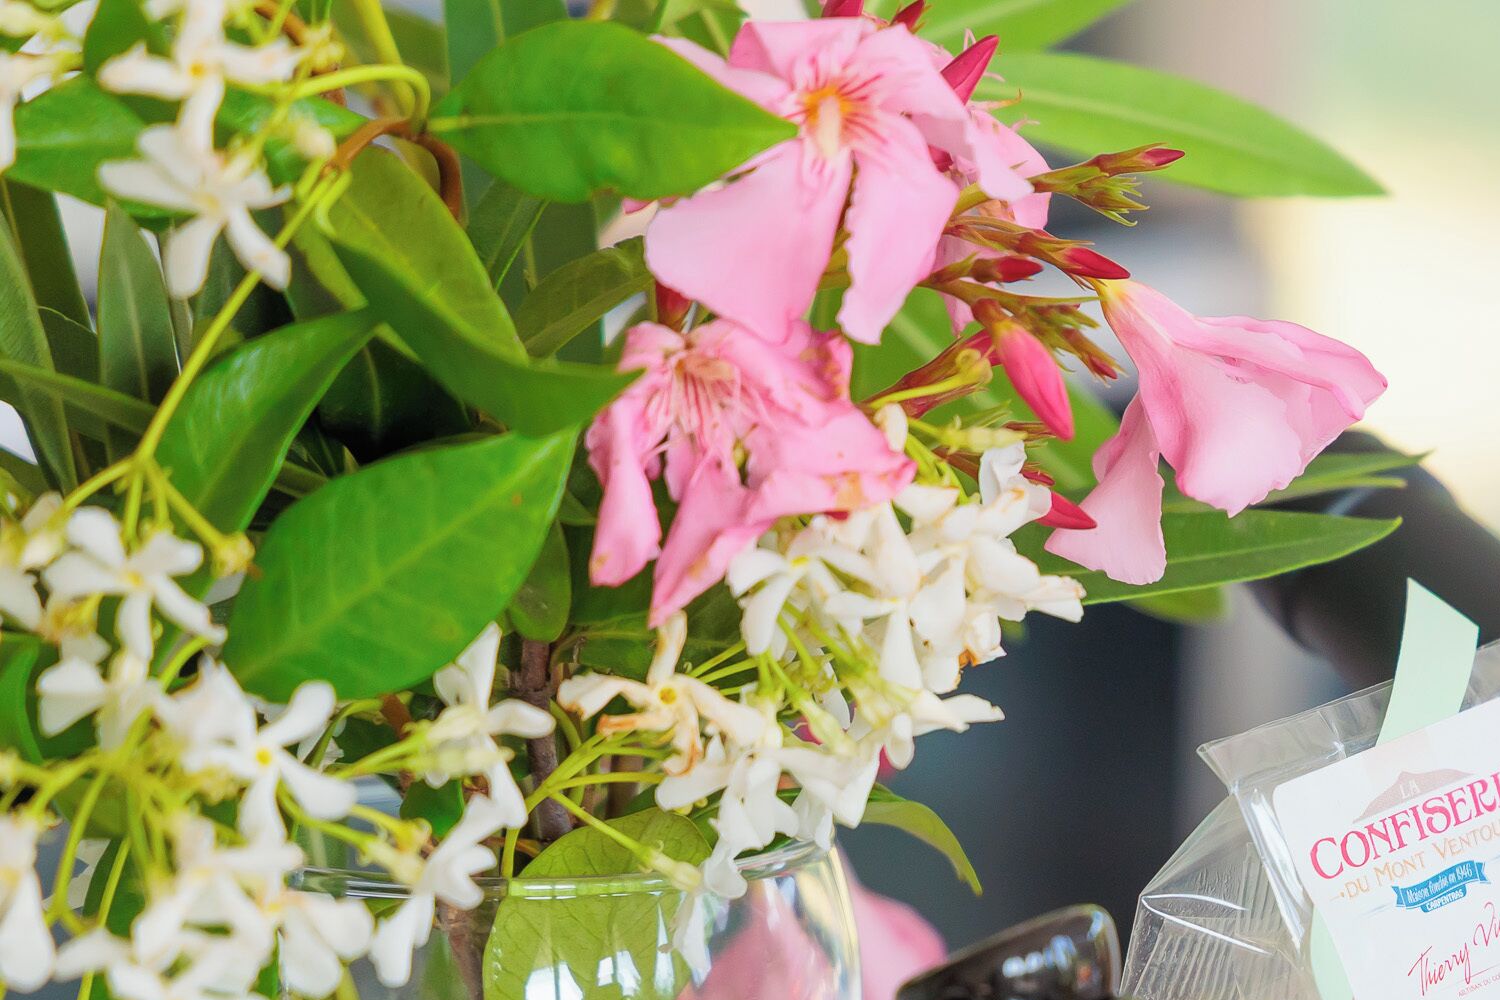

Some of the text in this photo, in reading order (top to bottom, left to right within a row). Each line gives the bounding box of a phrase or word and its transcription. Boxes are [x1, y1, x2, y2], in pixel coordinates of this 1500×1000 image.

[1400, 780, 1419, 799] LA
[1344, 877, 1370, 899] DU
[1374, 851, 1425, 887] MONT
[1456, 863, 1473, 881] 1946
[1426, 888, 1464, 911] CARPENTRAS
[1408, 943, 1472, 996] Thierry
